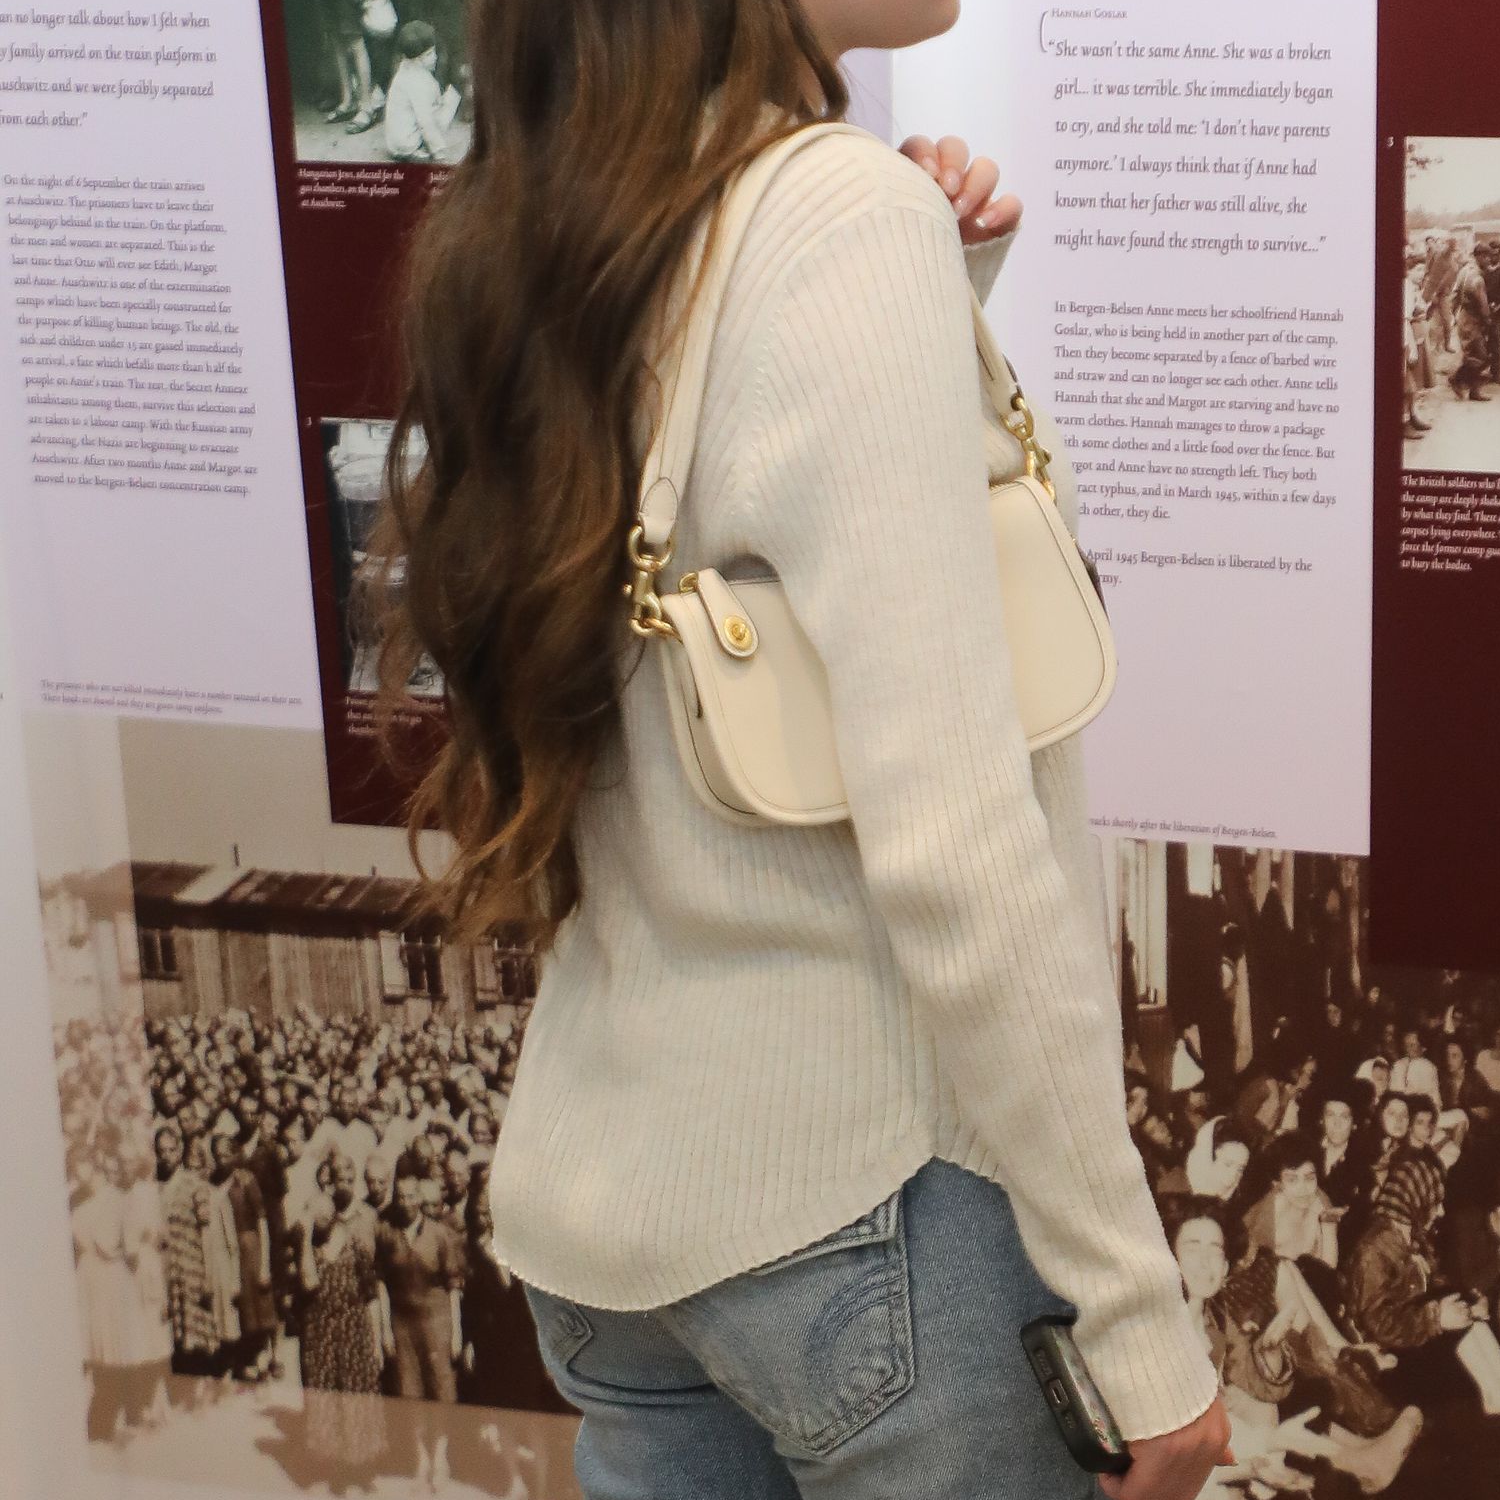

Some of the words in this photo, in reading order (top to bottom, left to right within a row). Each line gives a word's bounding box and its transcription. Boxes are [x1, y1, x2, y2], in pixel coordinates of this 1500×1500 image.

[1080, 40, 1122, 57] wasn’t
[1125, 40, 1145, 57] the
[1147, 46, 1180, 58] same
[1222, 41, 1245, 59] She
[1248, 48, 1272, 60] was
[1275, 48, 1283, 59] a
[1288, 42, 1331, 60] broken
